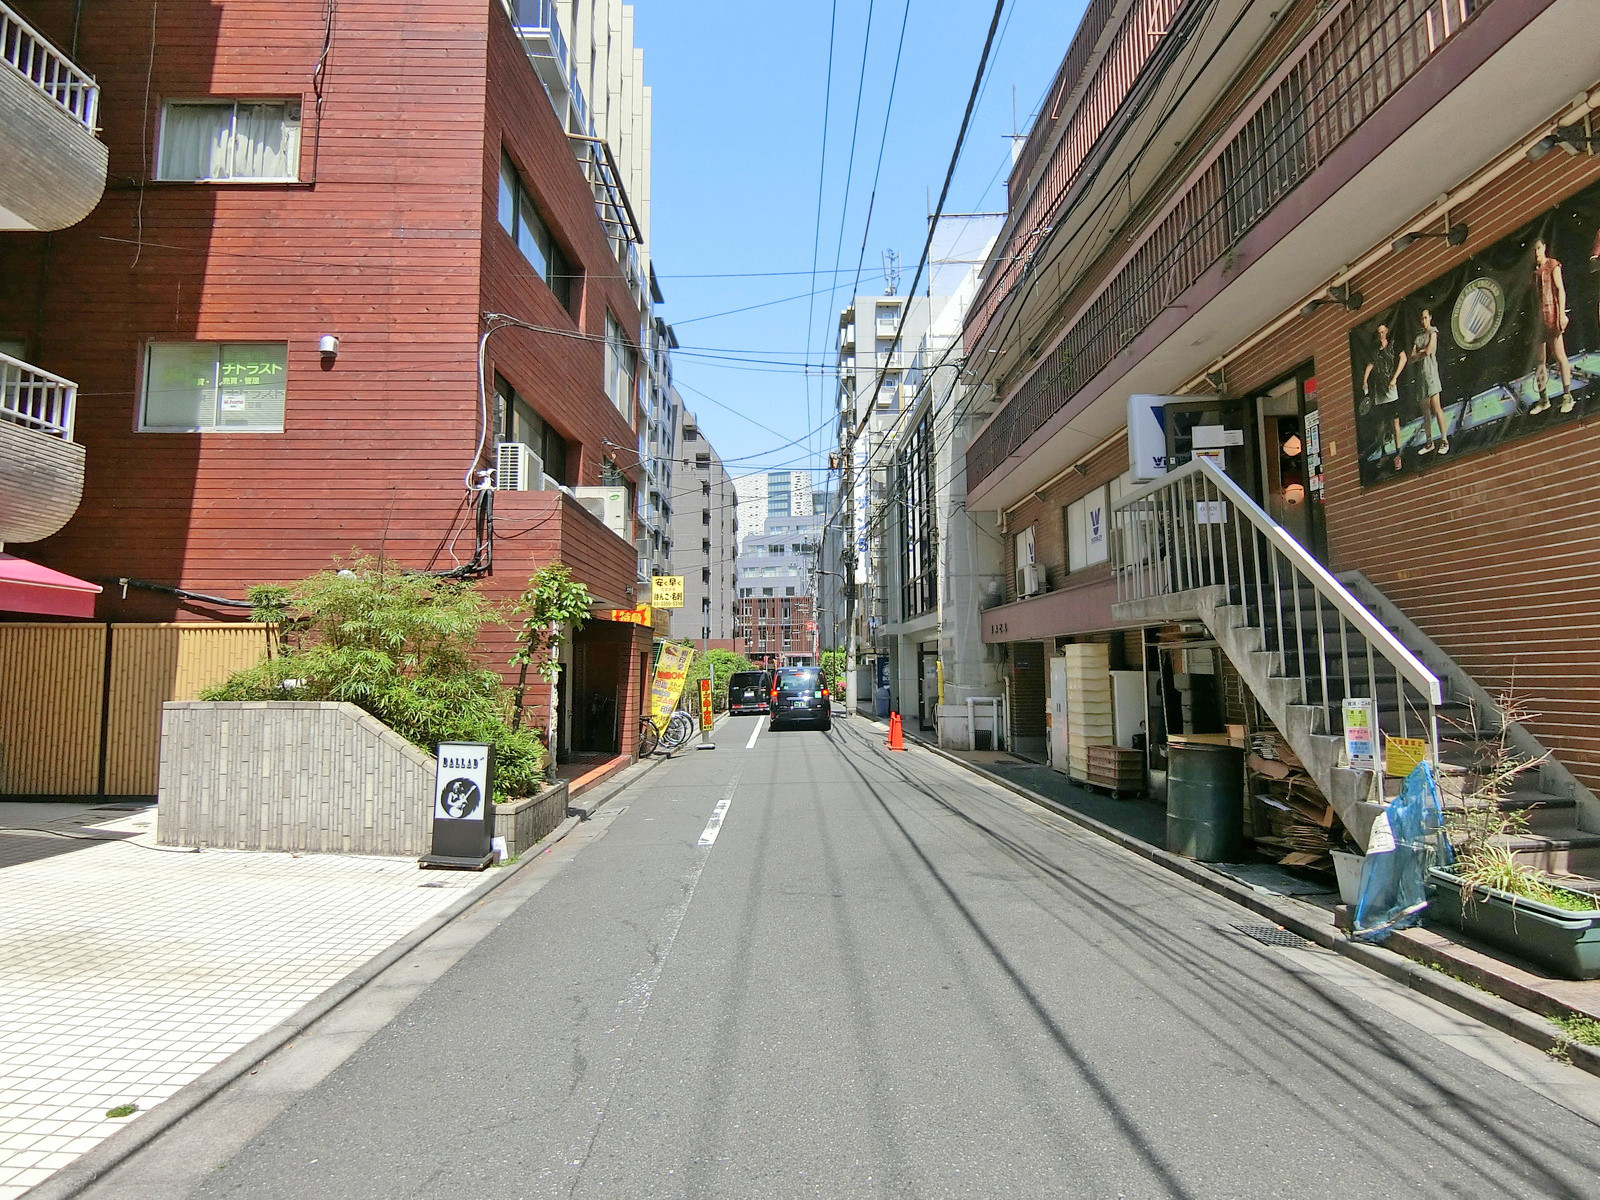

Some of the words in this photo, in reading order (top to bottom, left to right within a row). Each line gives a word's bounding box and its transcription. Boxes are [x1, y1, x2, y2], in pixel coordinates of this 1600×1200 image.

[655, 577, 682, 587] 安く早く
[442, 757, 479, 769] BALLAD
